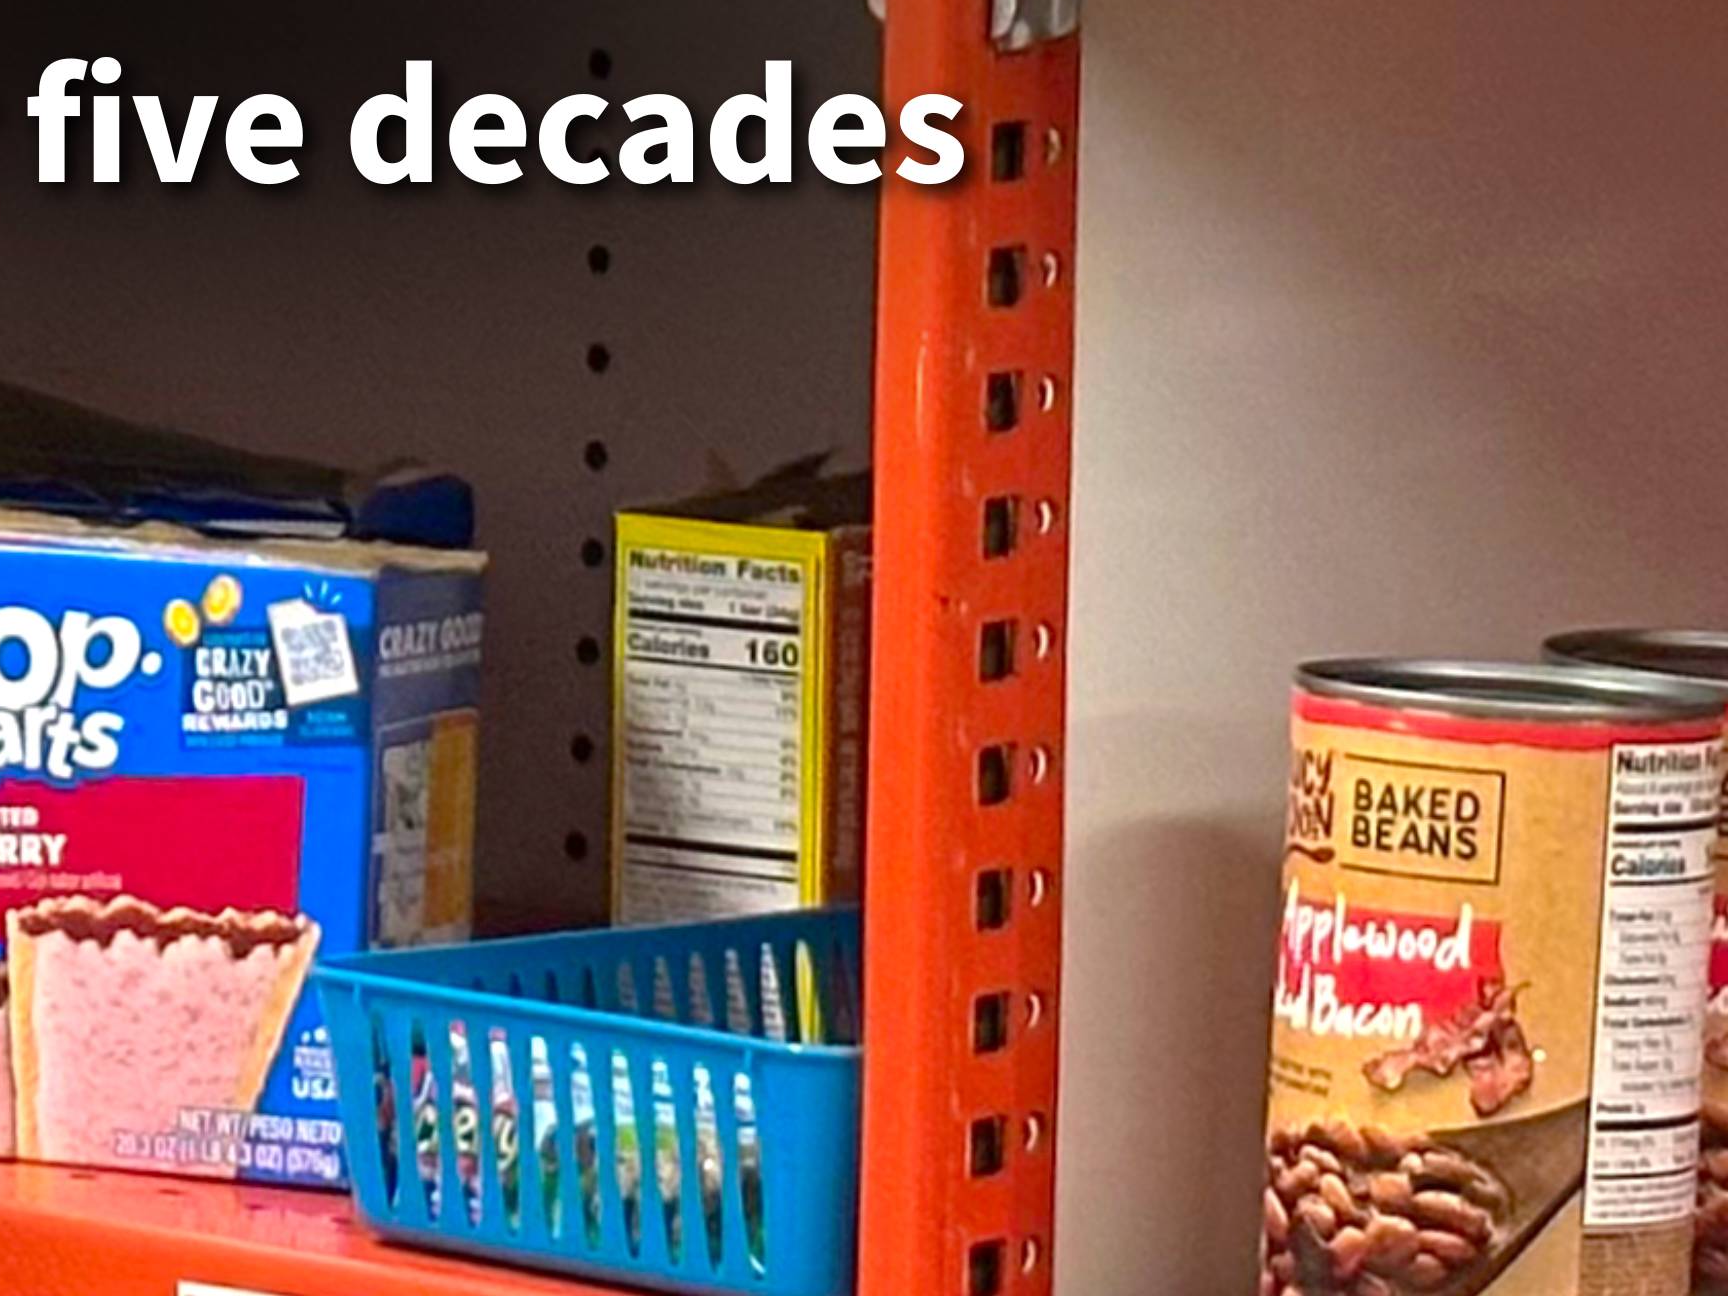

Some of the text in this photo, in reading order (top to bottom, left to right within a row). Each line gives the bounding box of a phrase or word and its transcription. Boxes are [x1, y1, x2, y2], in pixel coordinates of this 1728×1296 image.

[628, 550, 801, 584] Nutrition Facts
[378, 614, 485, 661] CRAZY GOOD
[627, 631, 800, 668] Calories 160
[194, 647, 273, 679] CRAZY
[192, 681, 272, 714] GOOD
[181, 710, 290, 733] REWARDS
[1615, 749, 1701, 778] Nutrition
[1352, 777, 1481, 823] BAKED
[1350, 813, 1480, 861] BEANS
[1609, 852, 1686, 877] Calories
[1283, 878, 1473, 972] Applewood
[1312, 979, 1423, 1039] Bacon
[292, 1076, 338, 1100] USA
[180, 1110, 213, 1133] NET
[296, 1118, 342, 1144] NETO
[154, 1135, 177, 1161] OZ
